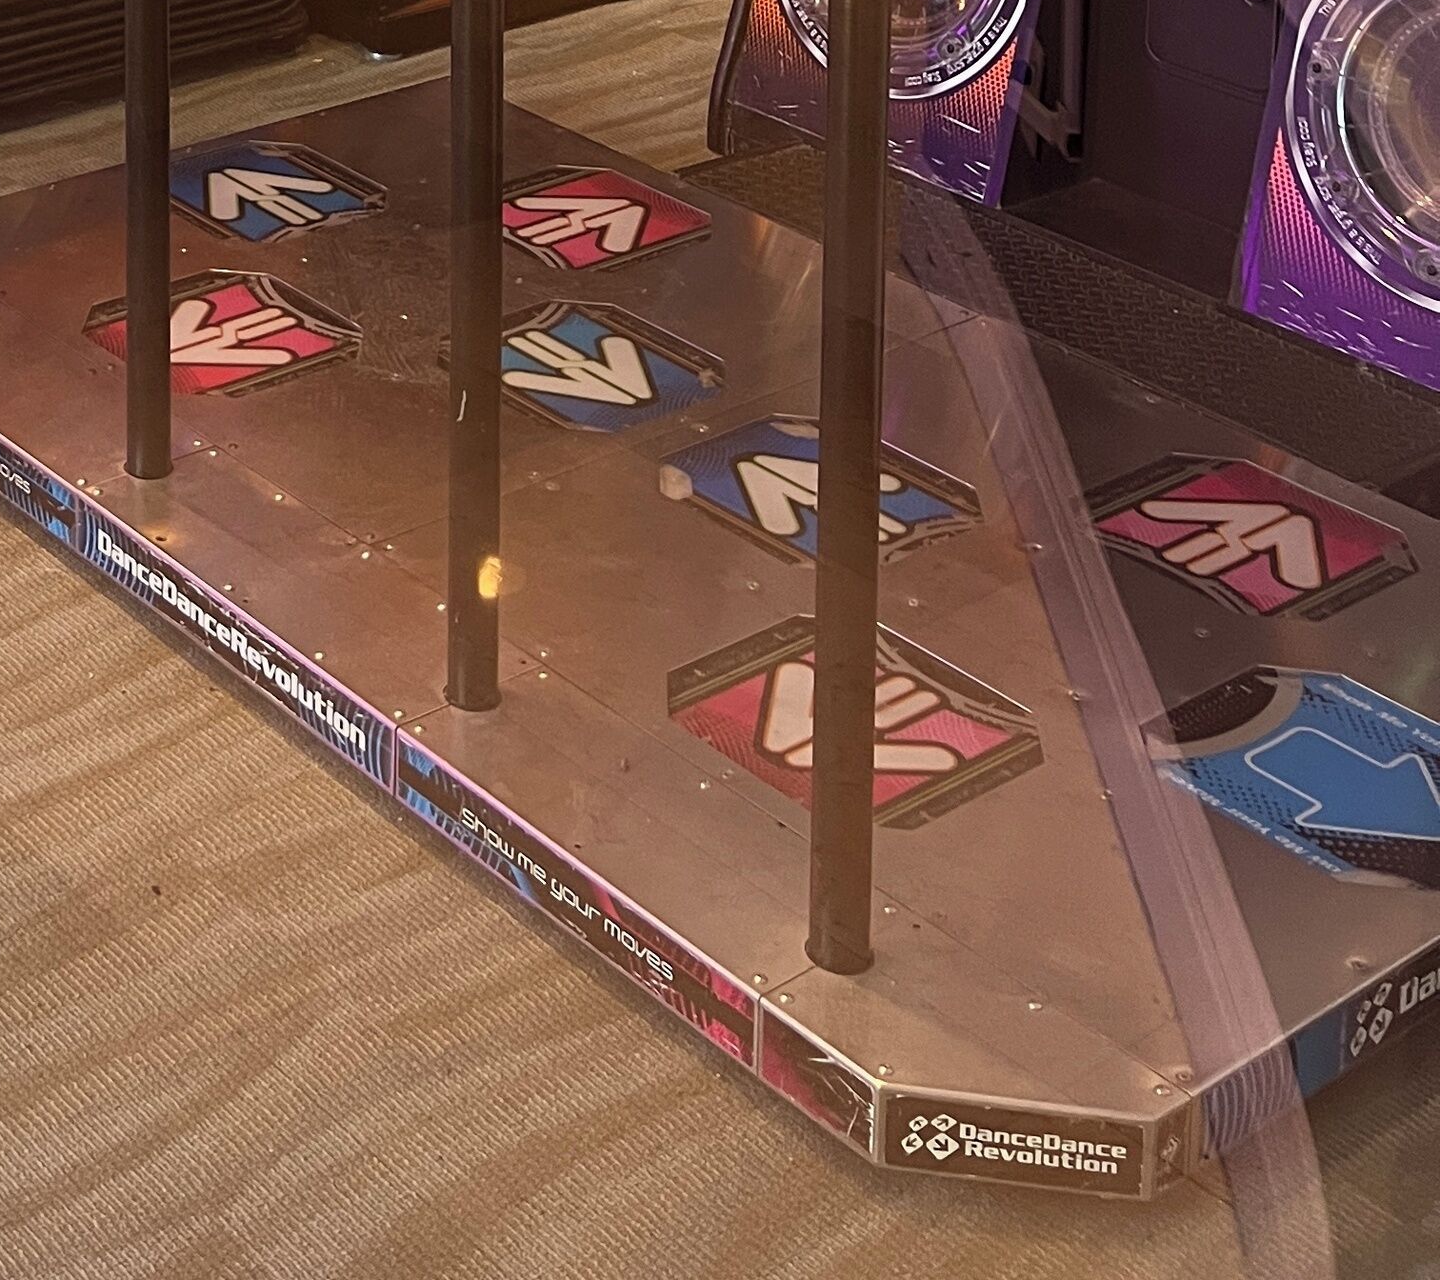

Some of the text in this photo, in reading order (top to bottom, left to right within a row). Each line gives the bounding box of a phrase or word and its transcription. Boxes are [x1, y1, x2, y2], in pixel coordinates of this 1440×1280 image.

[97, 528, 367, 751] DanceDanceRevolution
[461, 807, 675, 982] Show me your moves
[959, 1122, 1128, 1160] DanceDance
[964, 1140, 1119, 1175] Revolution
